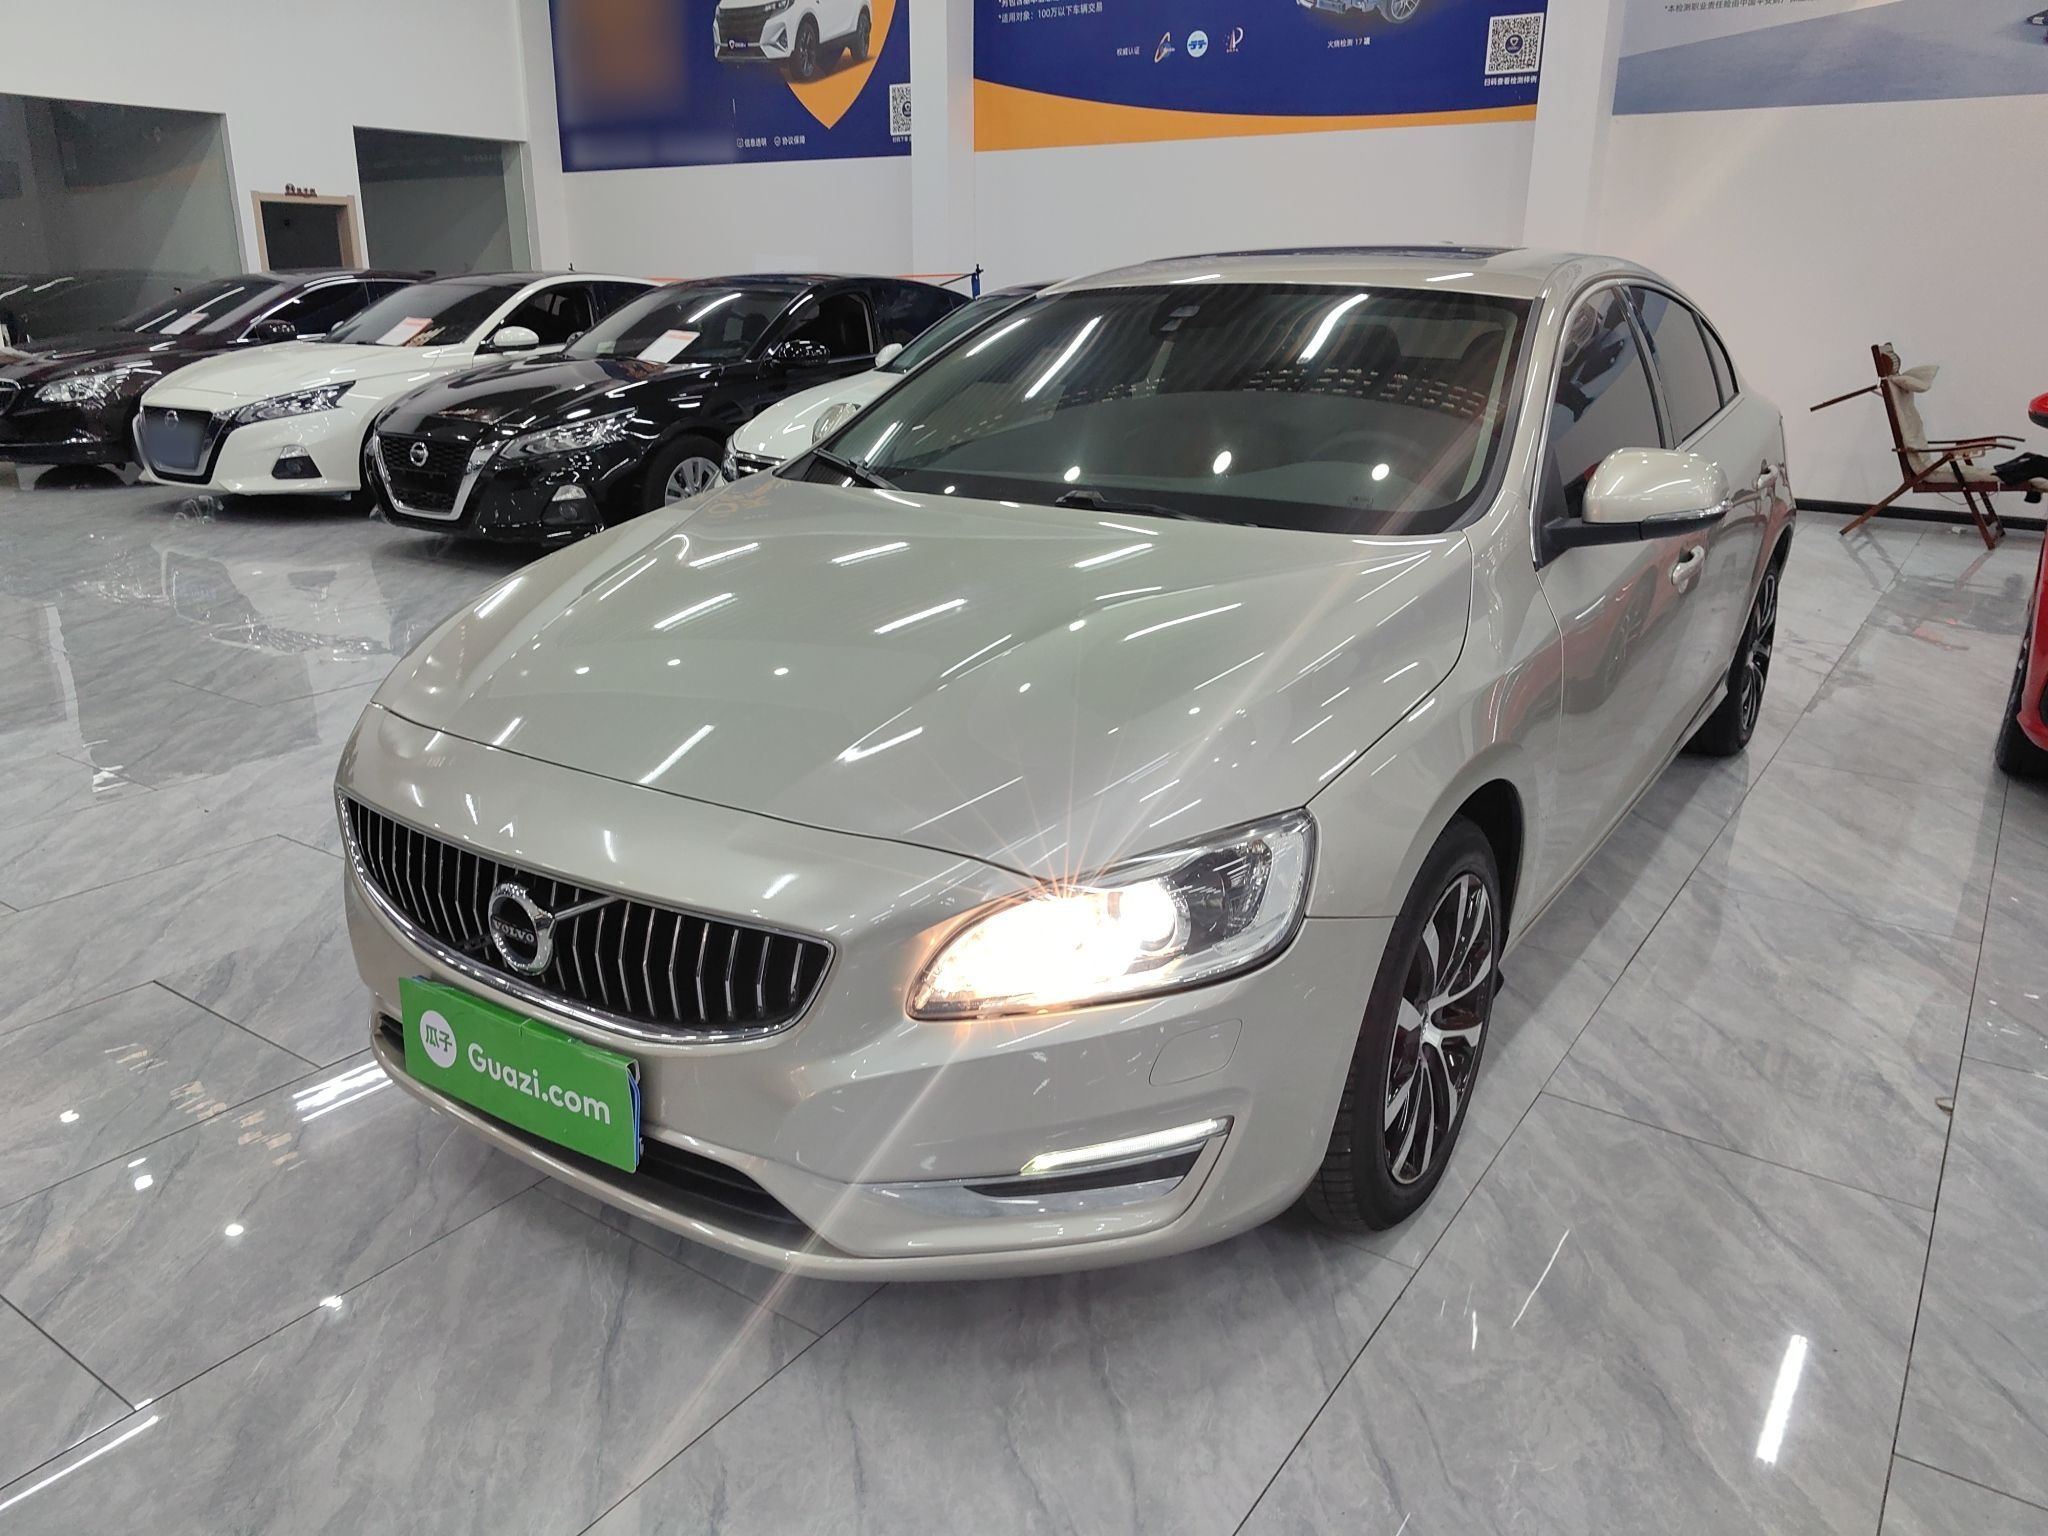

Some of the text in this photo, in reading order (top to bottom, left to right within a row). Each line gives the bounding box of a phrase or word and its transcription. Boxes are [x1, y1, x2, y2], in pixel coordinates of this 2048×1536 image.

[493, 919, 535, 943] VOLVO
[425, 1023, 453, 1053] 瓜子
[467, 1042, 611, 1125] Guazi.com
